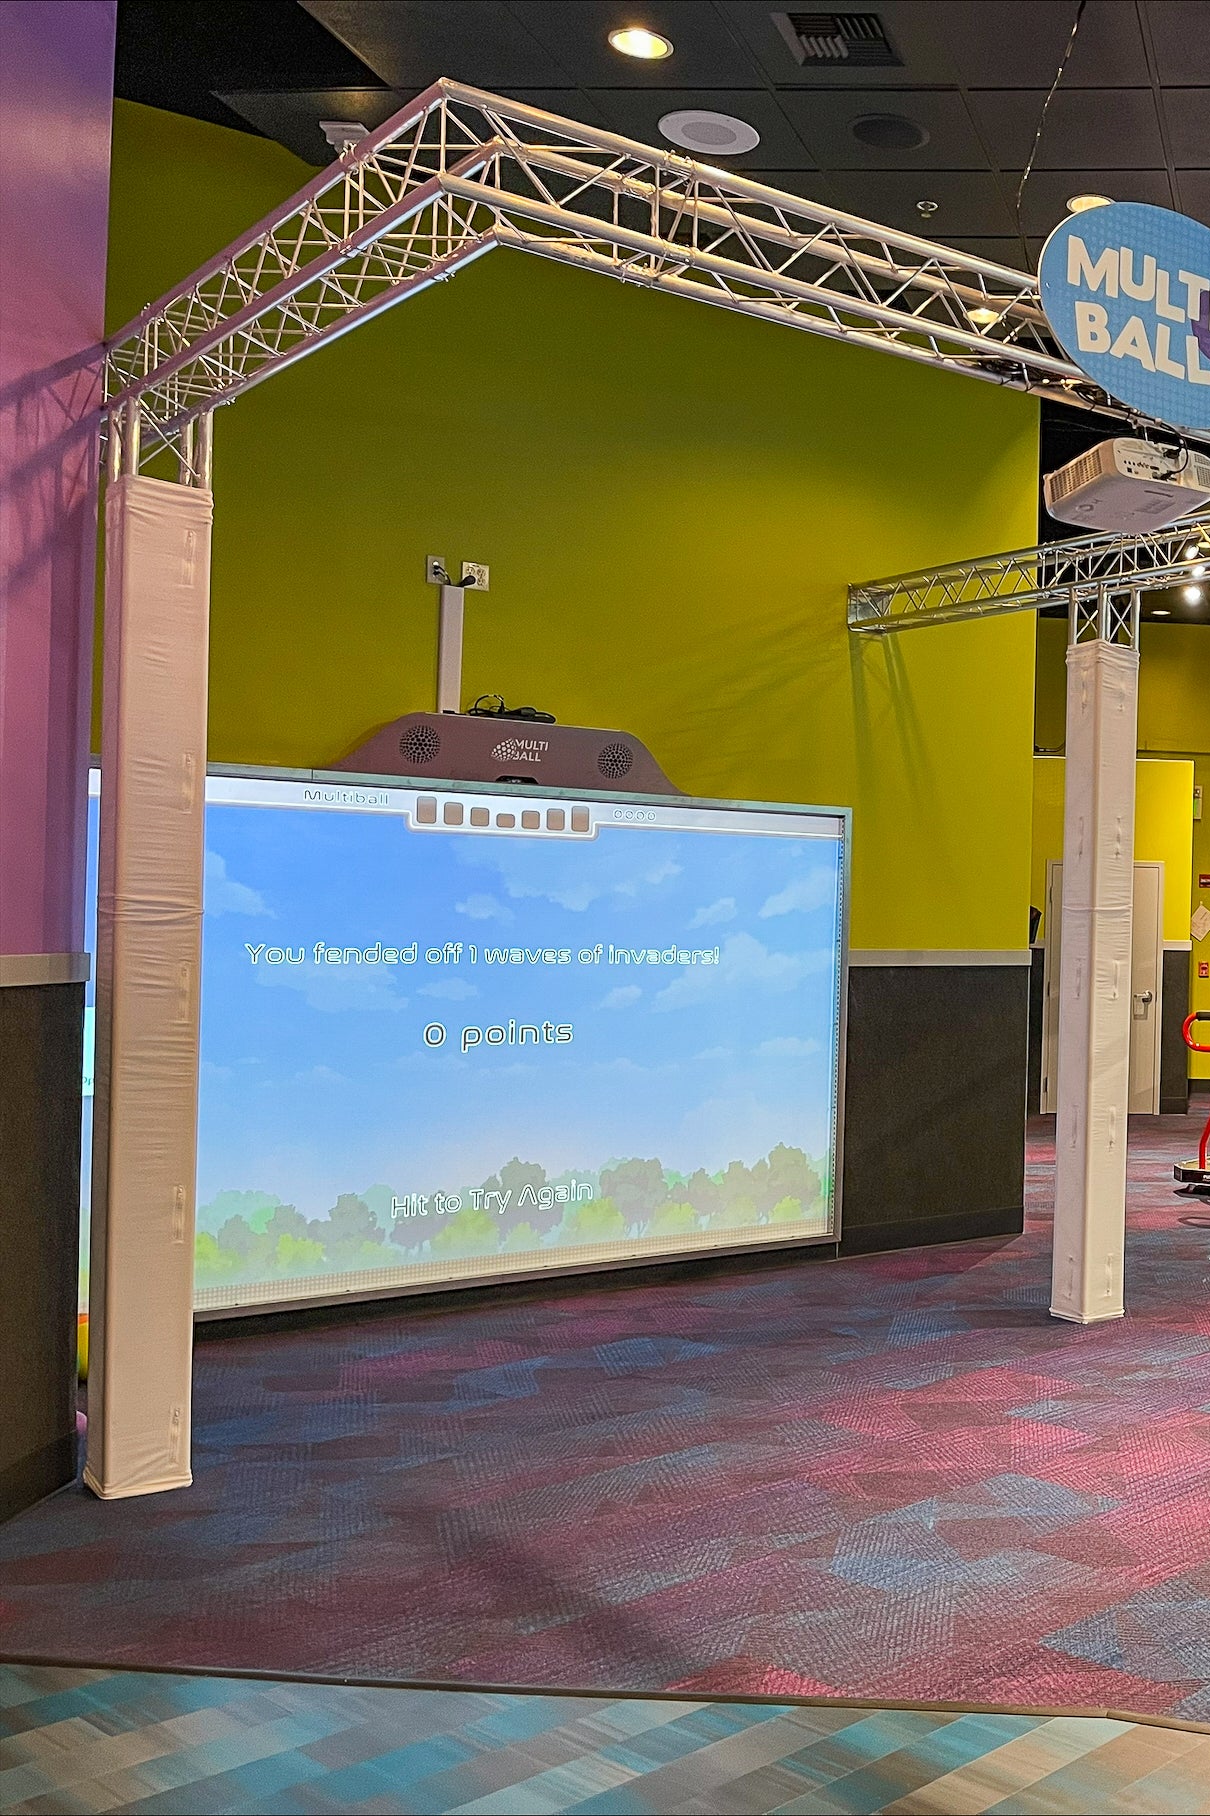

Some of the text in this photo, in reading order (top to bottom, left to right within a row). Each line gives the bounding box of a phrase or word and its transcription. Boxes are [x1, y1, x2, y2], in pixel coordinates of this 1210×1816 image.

[514, 738, 549, 751] MULTI
[303, 788, 389, 806] Multiball
[245, 941, 720, 965] You fended off 1 waves of invaders!
[461, 1018, 574, 1053] points
[391, 1178, 594, 1219] Hit to Try Again
